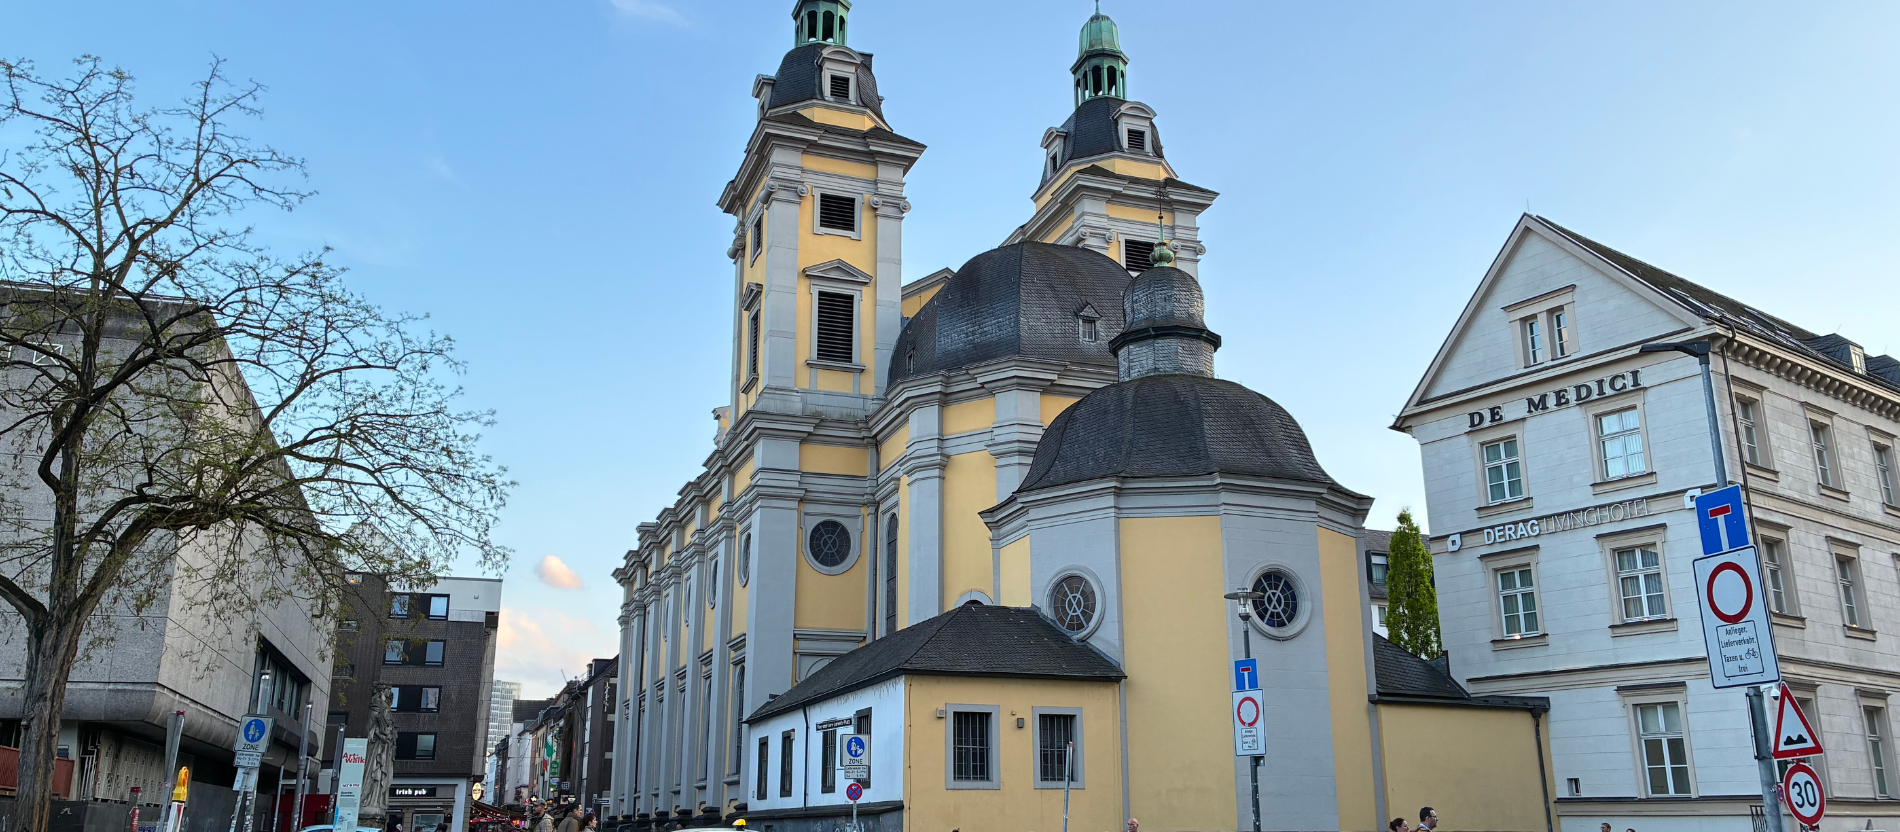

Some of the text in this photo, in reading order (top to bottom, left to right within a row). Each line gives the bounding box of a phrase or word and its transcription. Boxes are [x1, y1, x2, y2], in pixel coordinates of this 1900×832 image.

[1468, 369, 1642, 428] DE MEDICI
[1483, 498, 1648, 545] DERAG LIVINGHOTEL
[242, 743, 260, 751] ZONE
[413, 788, 427, 797] pub
[1791, 780, 1817, 809] 30
